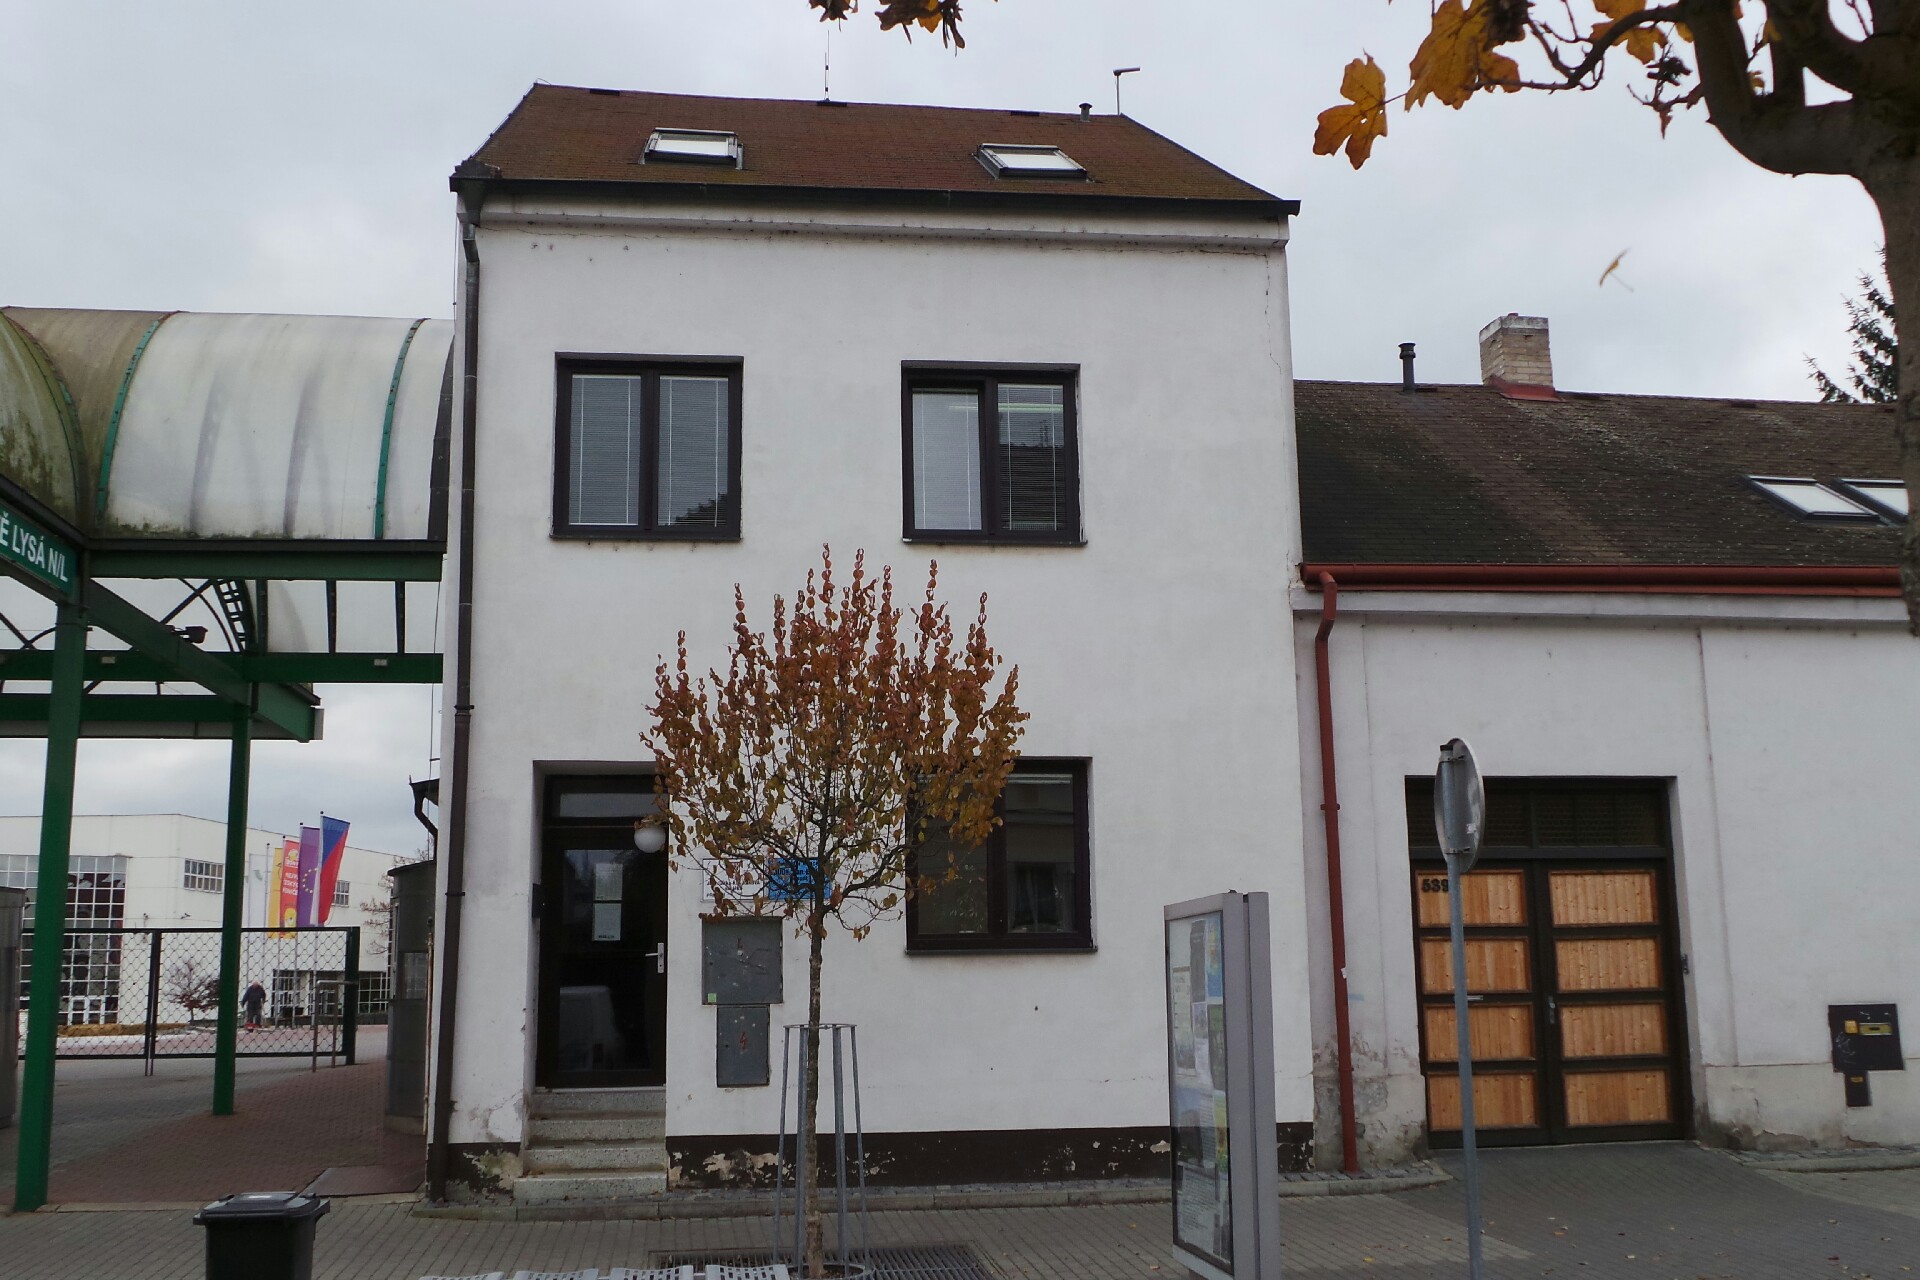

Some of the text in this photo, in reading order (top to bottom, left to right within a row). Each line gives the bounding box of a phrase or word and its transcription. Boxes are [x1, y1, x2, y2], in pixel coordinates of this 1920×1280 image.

[12, 525, 45, 569] LYSÁ
[48, 548, 68, 582] N/L
[1422, 879, 1449, 892] 539
